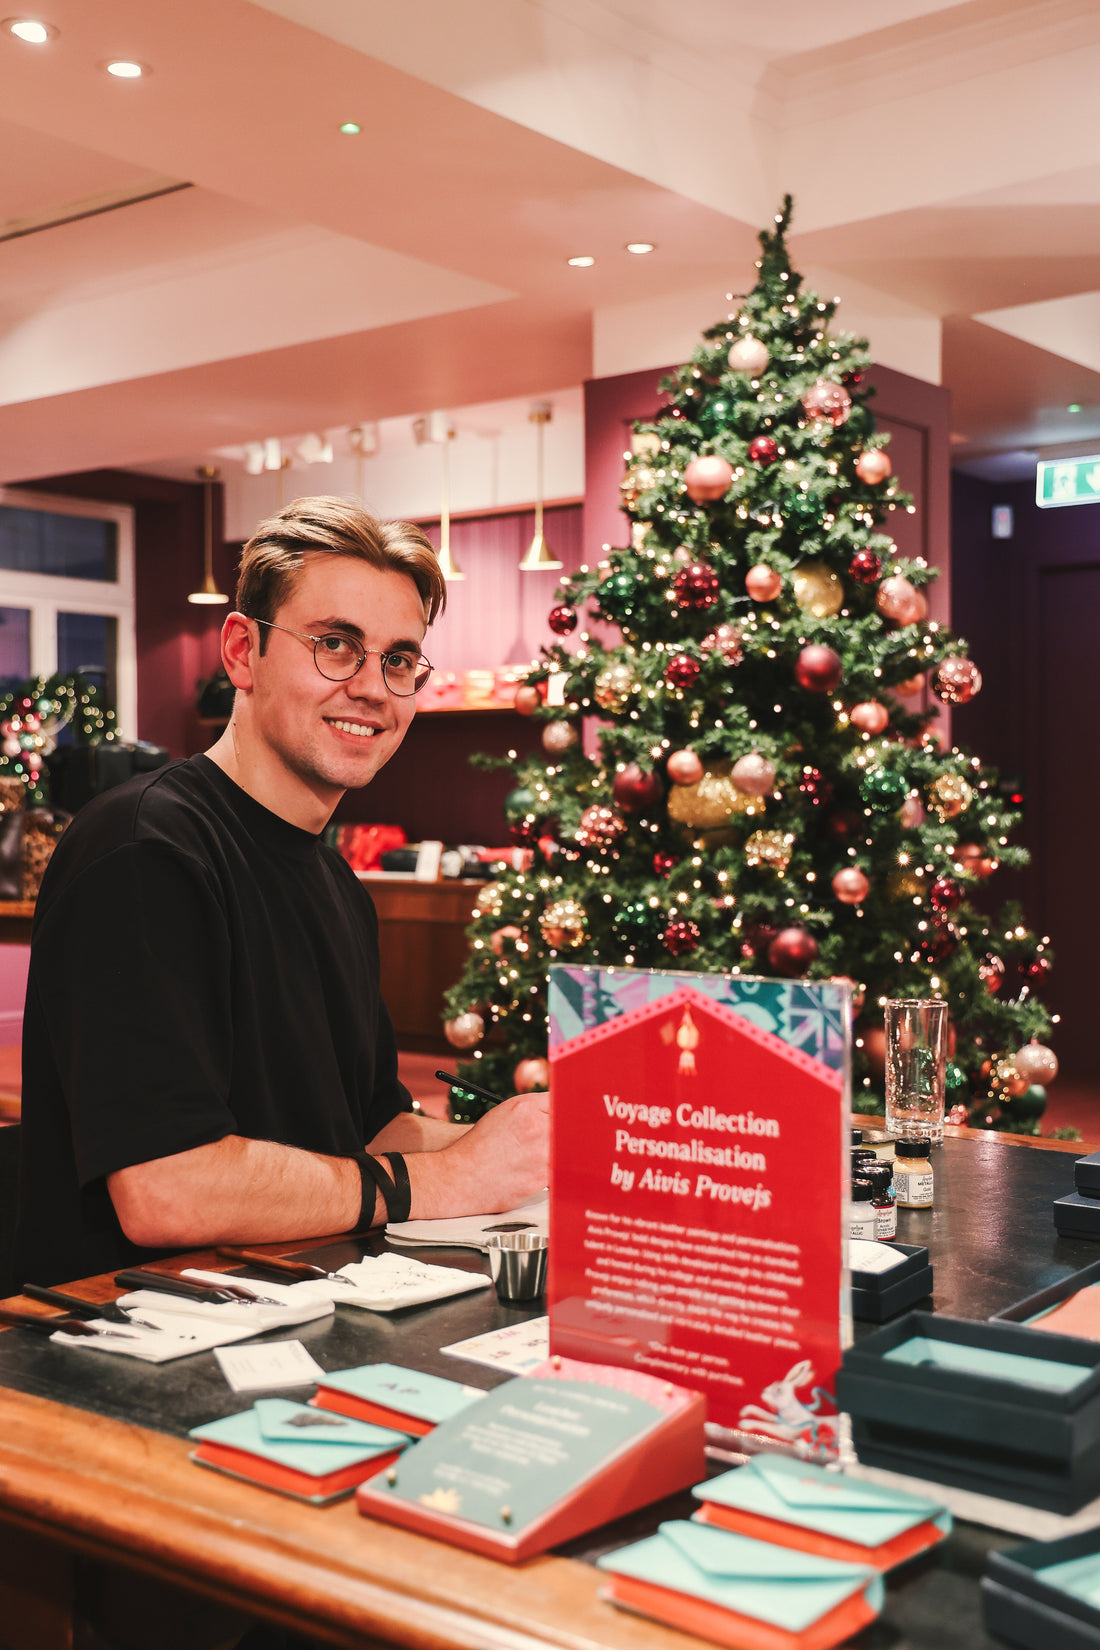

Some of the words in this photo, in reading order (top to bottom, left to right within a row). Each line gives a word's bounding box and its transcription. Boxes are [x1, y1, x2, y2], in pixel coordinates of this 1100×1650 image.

[603, 1094, 672, 1128] Voyage
[676, 1103, 780, 1138] Collection
[615, 1129, 766, 1171] Personalisation
[610, 1162, 635, 1192] by
[638, 1167, 690, 1195] Aivis
[695, 1174, 772, 1211] Provejs
